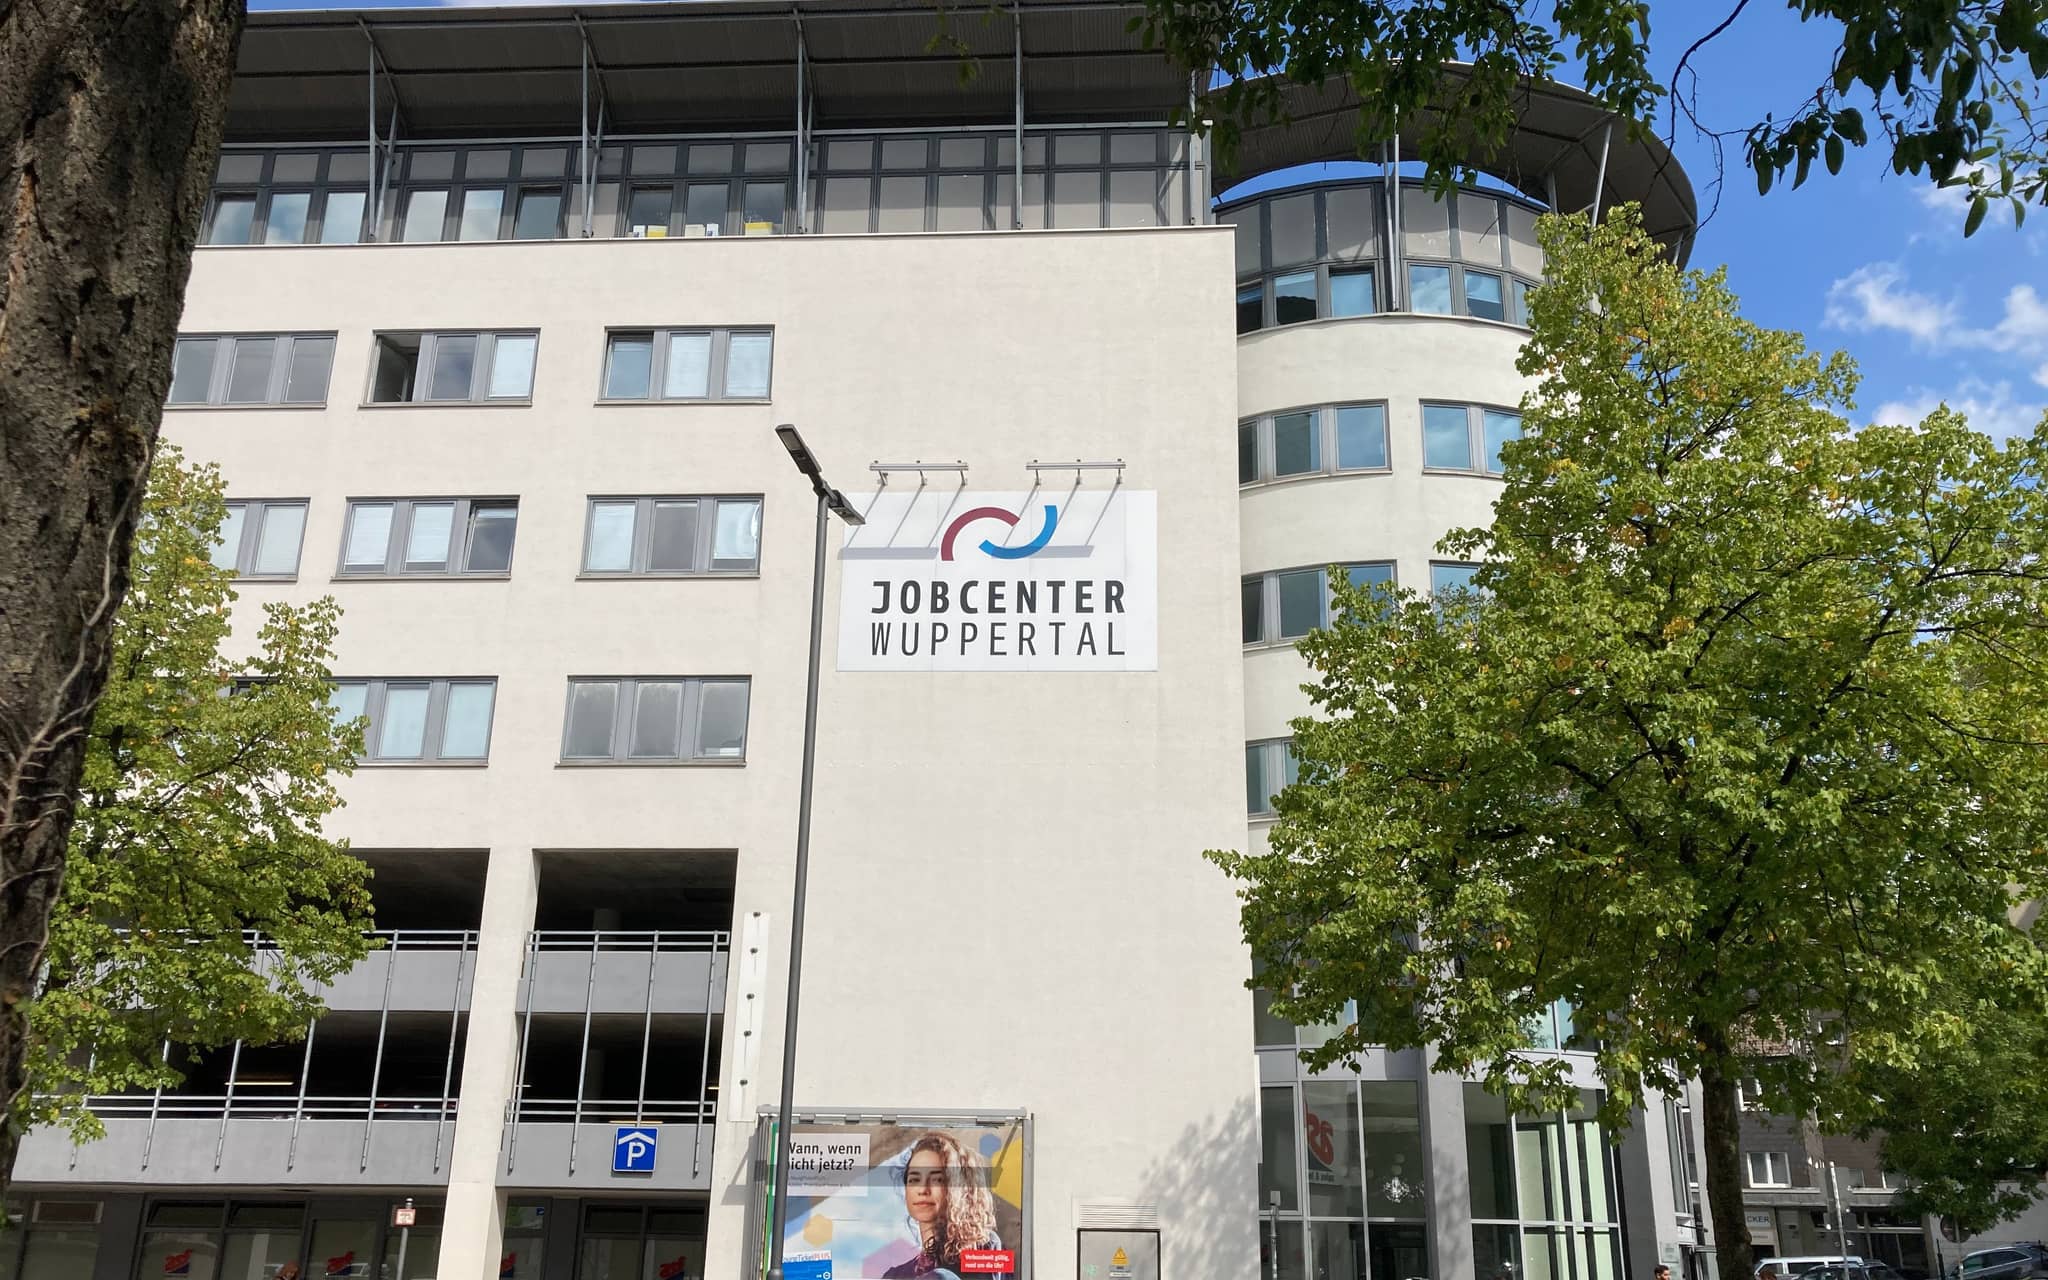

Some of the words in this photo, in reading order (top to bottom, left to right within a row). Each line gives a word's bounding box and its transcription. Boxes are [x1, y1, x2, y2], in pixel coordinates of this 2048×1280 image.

[871, 580, 1126, 614] JOBCENTER
[871, 622, 1126, 656] WUPPERTAL
[627, 1141, 645, 1167] P
[828, 1144, 862, 1154] wenn
[788, 1157, 815, 1170] icht
[818, 1158, 855, 1173] jetzt?
[1747, 1215, 1769, 1223] CKER
